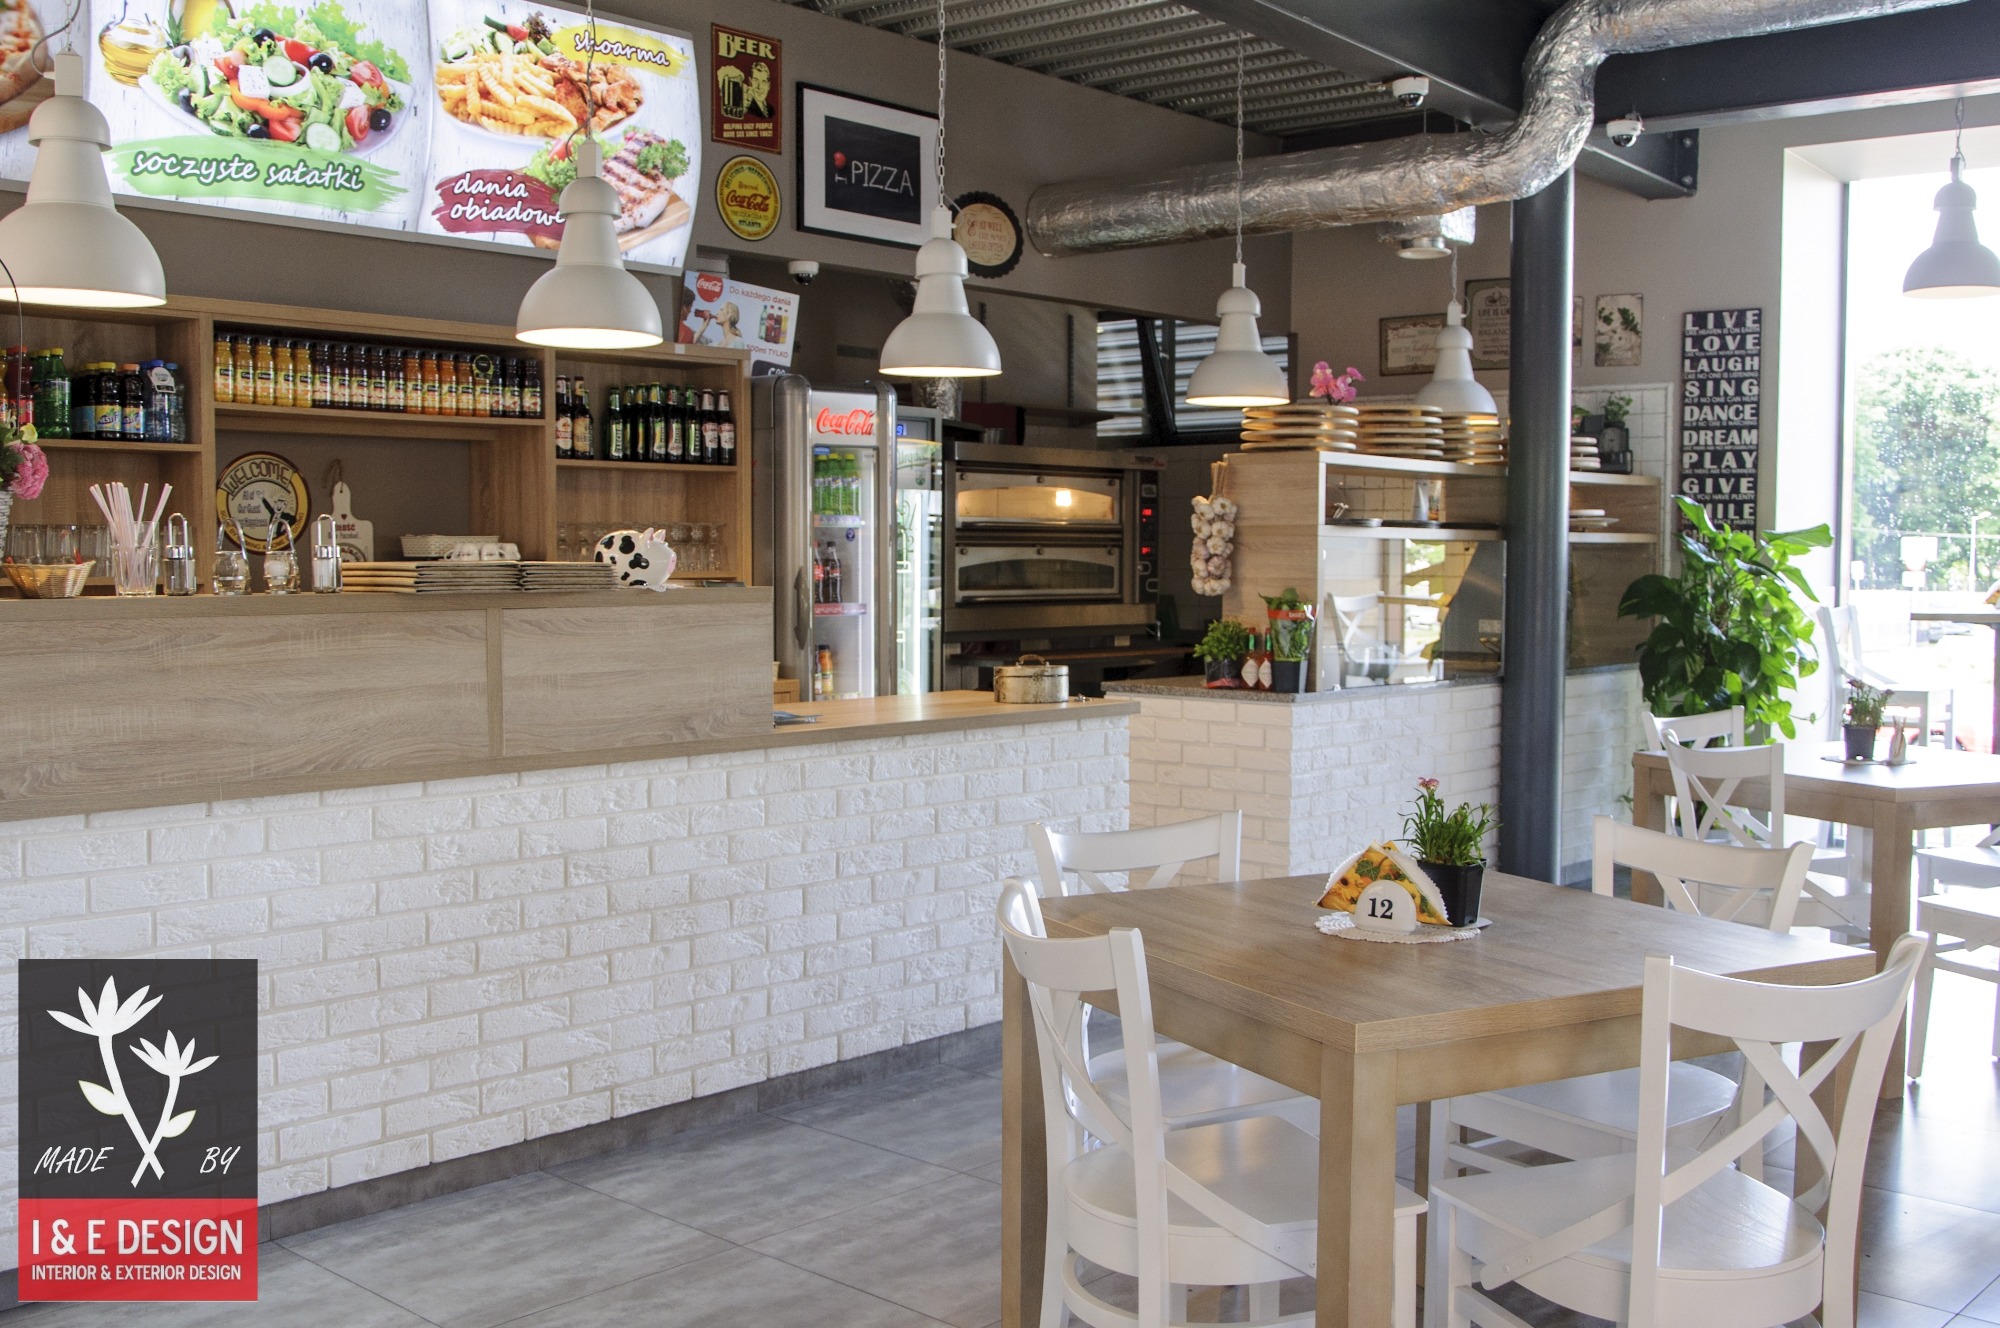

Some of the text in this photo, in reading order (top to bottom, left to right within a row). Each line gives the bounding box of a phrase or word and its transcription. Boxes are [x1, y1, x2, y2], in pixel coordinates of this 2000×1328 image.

[717, 32, 776, 60] BEER
[133, 152, 364, 191] soczyste sałatki
[851, 160, 914, 198] PIZZA
[453, 172, 529, 198] dania
[726, 189, 770, 212] Coca-Cola
[728, 286, 791, 306] Do każdego dania
[1685, 310, 1760, 331] LIVE
[1684, 334, 1760, 352] LOVE
[1684, 356, 1760, 373] LAUGH
[1685, 379, 1759, 398] SING
[816, 407, 876, 436] Coca-Cola
[1684, 404, 1758, 421] DANCE
[1683, 429, 1758, 446] DREAM
[1682, 451, 1757, 469] PLAY
[224, 460, 290, 495] WELCOME
[1682, 477, 1755, 494] GIVE
[1368, 897, 1394, 920] 12
